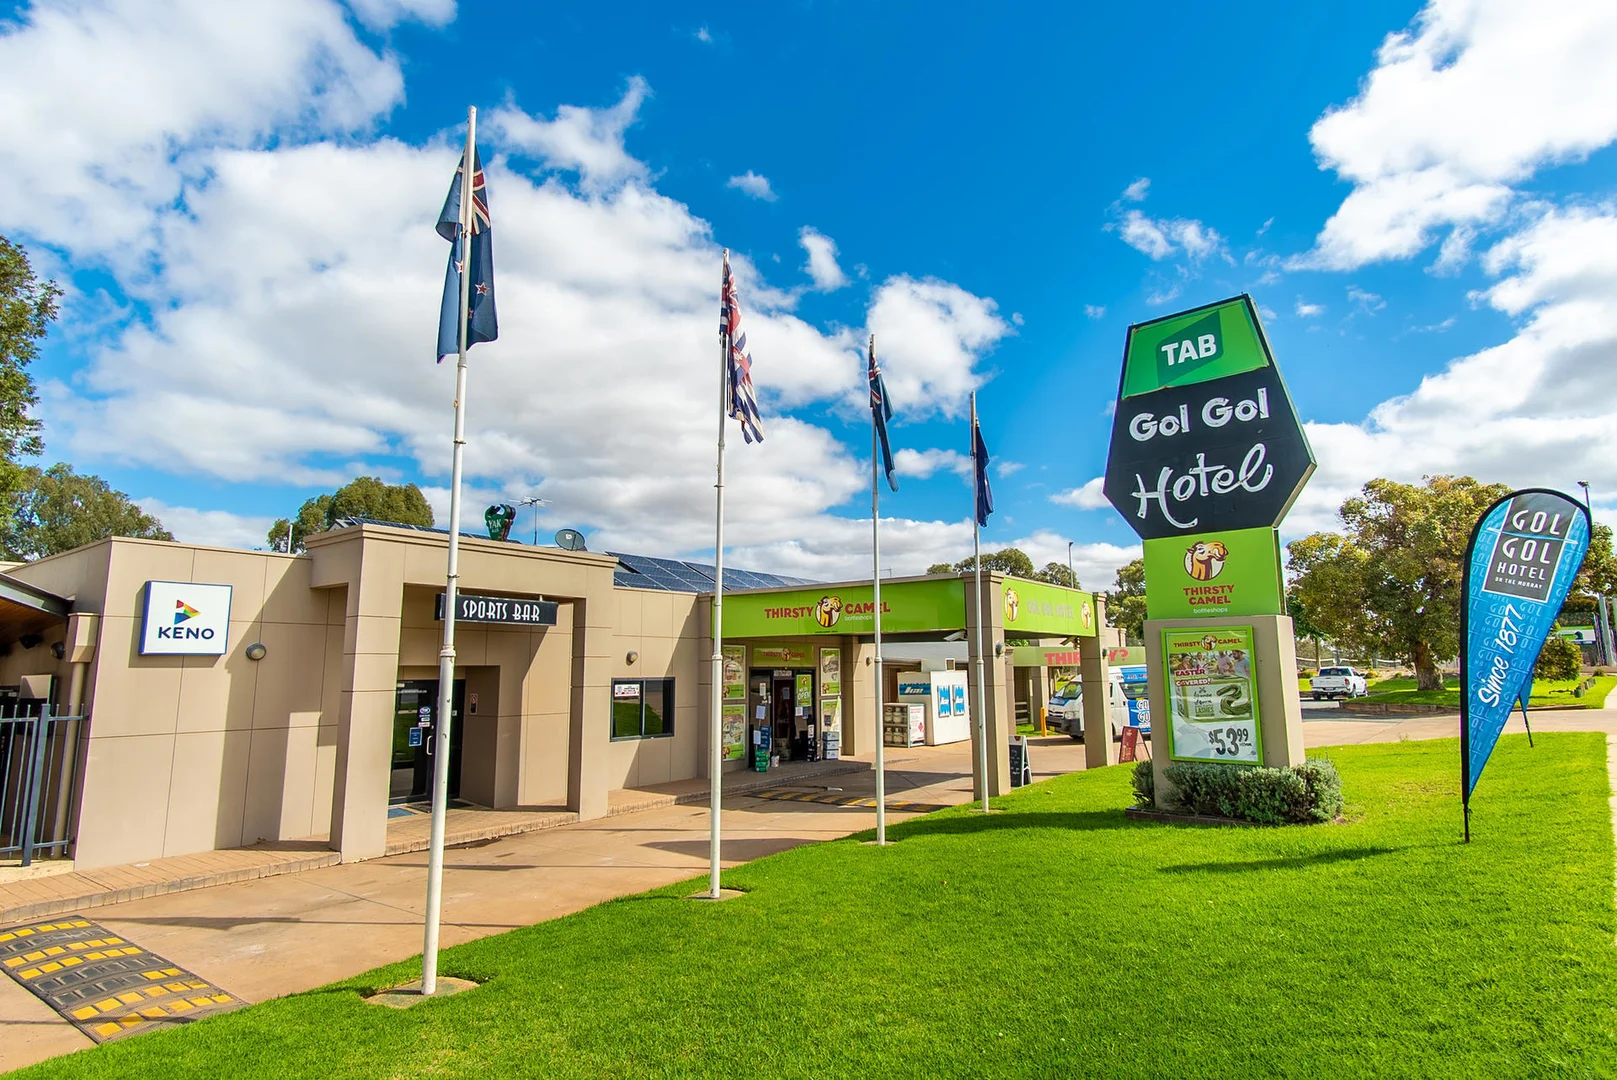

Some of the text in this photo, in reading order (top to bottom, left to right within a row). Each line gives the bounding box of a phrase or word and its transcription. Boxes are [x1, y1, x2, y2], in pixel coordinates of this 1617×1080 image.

[1161, 333, 1217, 366] TAB
[1129, 387, 1270, 442] Gol Gol
[1129, 442, 1275, 529] Hotel
[1512, 509, 1561, 535] GOL
[1502, 537, 1551, 564] GOL
[1496, 561, 1546, 581] HOTEL
[1183, 584, 1235, 596] THIRSTY
[1517, 580, 1543, 589] MURRAY
[1189, 595, 1231, 605] CAMEL
[463, 600, 540, 621] SPORTS BAR
[764, 606, 814, 619] THIRSTY
[158, 626, 215, 640] KENO
[1478, 656, 1509, 708] Since
[1494, 603, 1523, 654] 1877
[1175, 668, 1206, 677] EASTER
